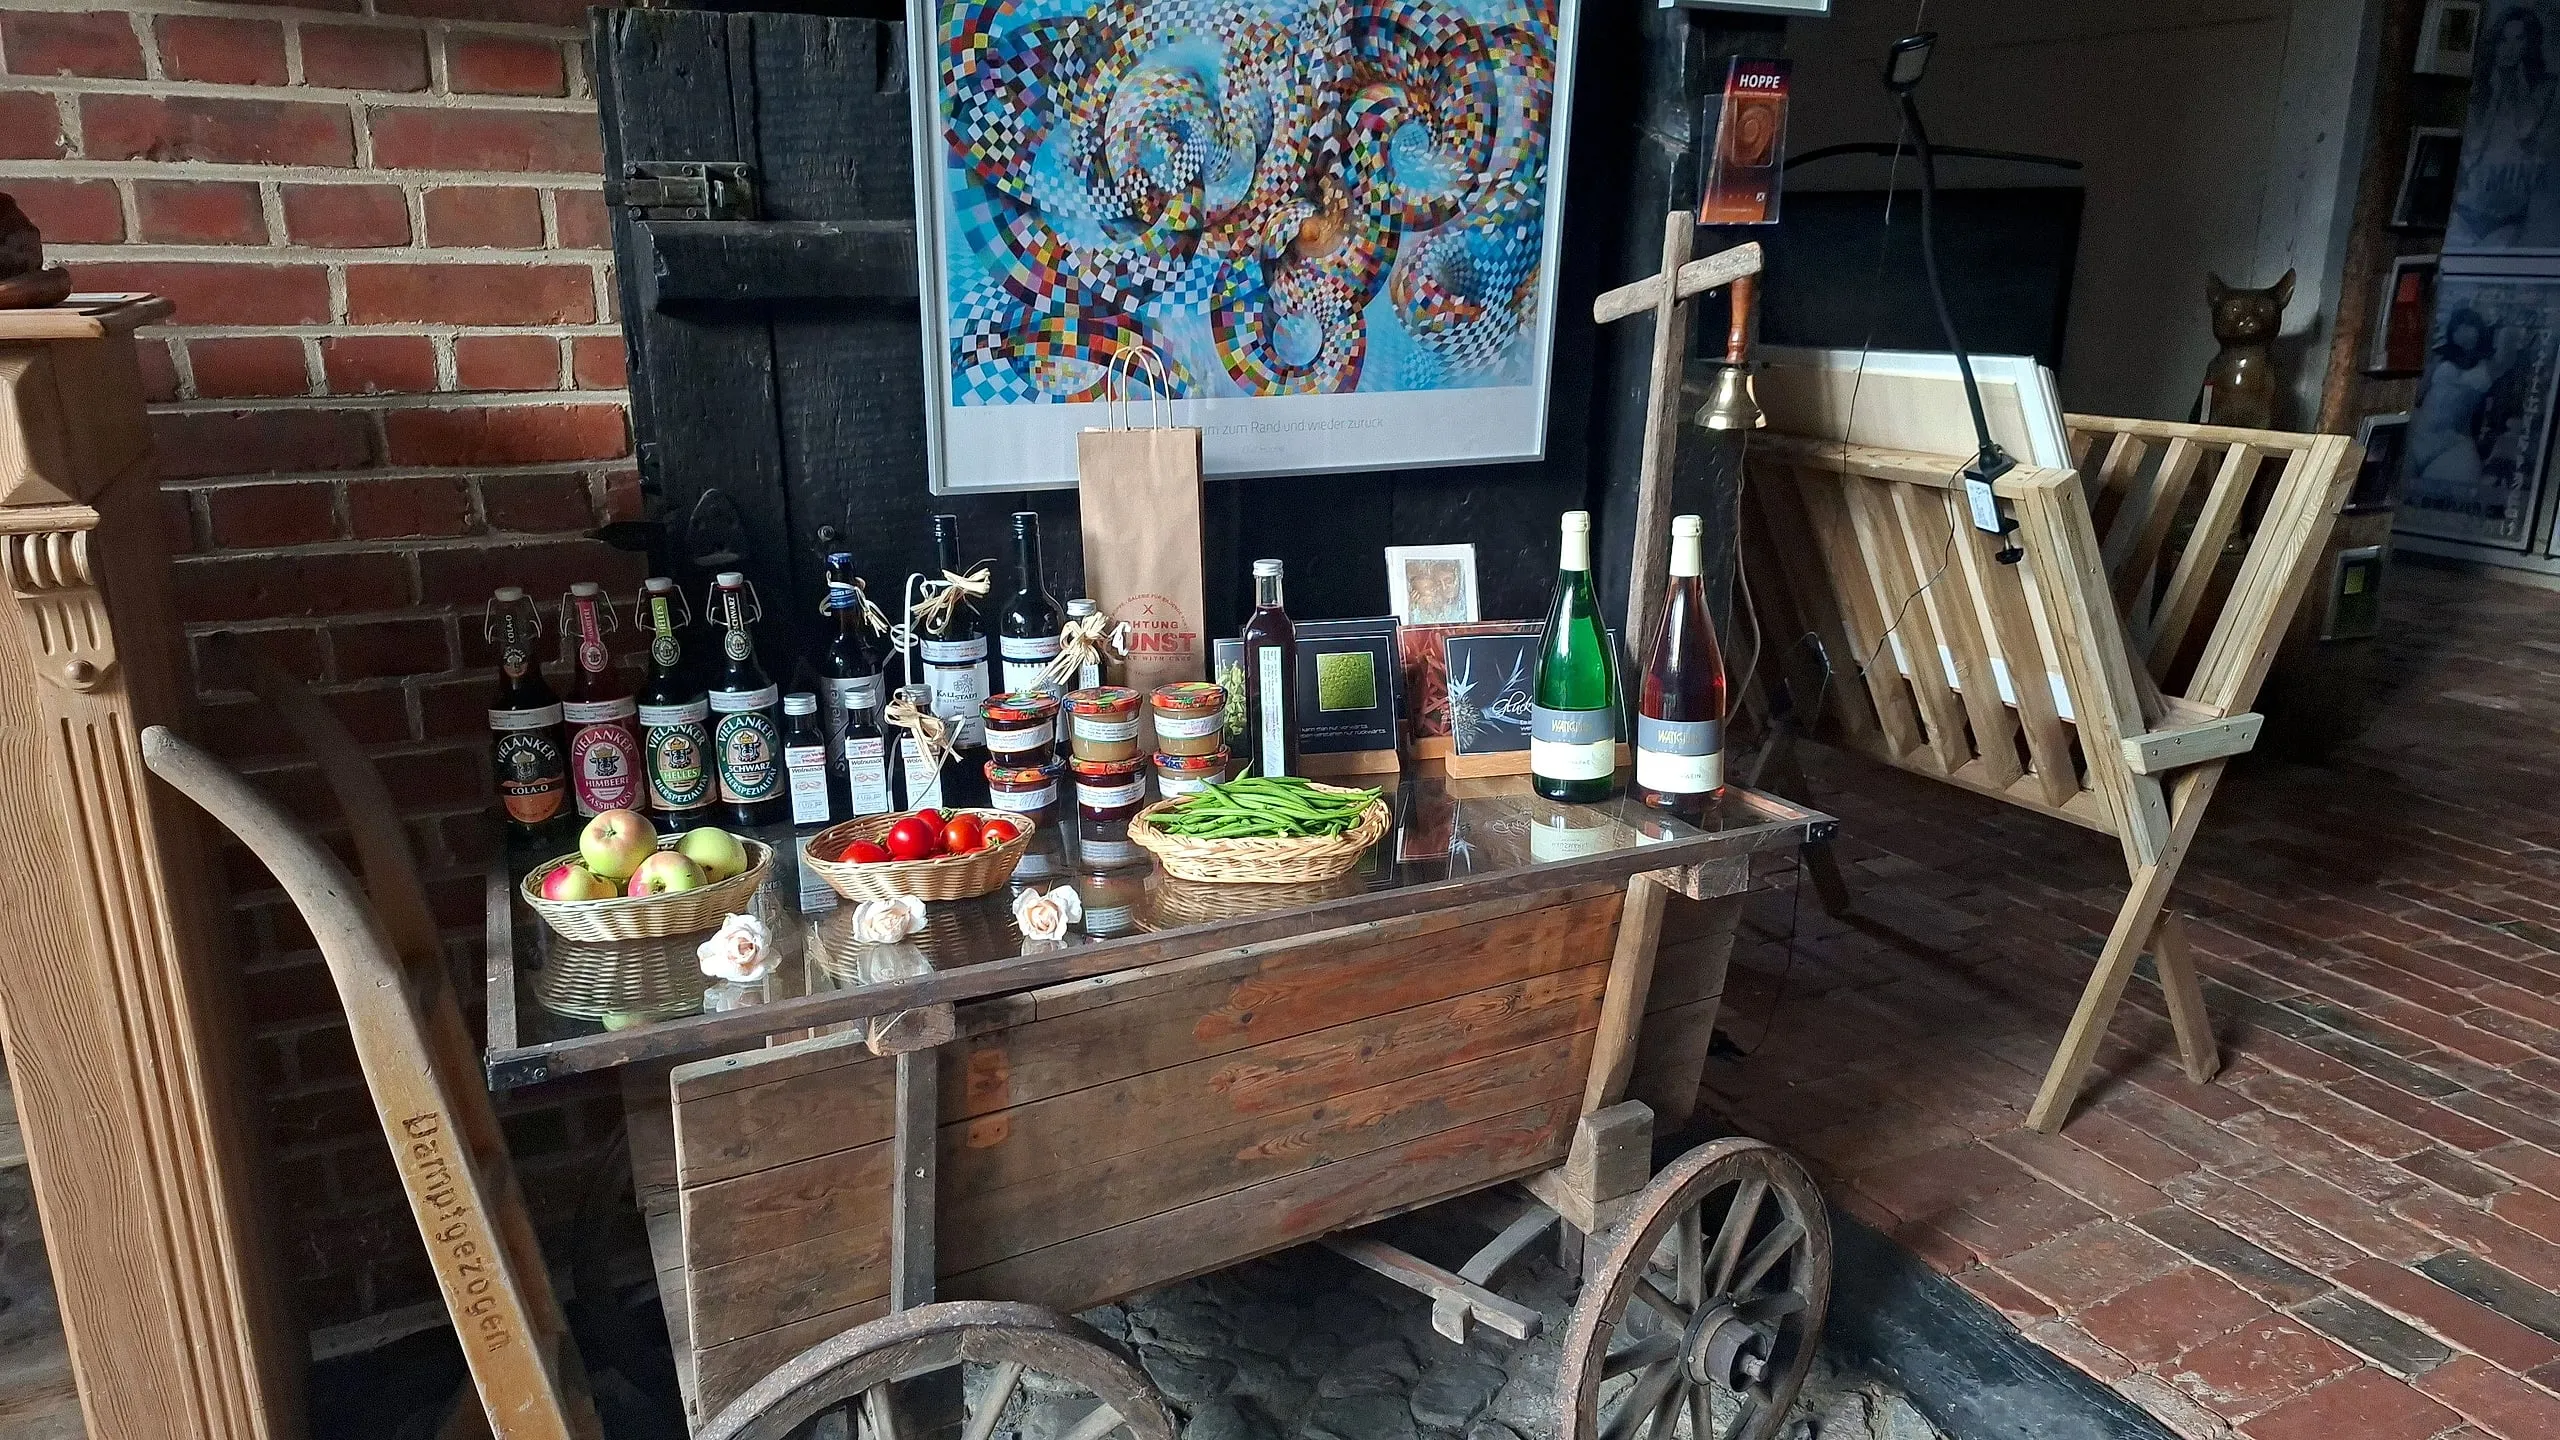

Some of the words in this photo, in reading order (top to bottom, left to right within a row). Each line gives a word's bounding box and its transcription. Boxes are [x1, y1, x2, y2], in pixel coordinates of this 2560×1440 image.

[1739, 75, 1781, 89] HOPPE
[1222, 424, 1248, 435] zum
[1251, 420, 1281, 433] Rand
[1284, 419, 1305, 432] und
[1307, 417, 1345, 431] wieder
[1126, 632, 1197, 652] UNST
[648, 724, 706, 749] VIELANKER
[718, 717, 774, 743] VIELANKER
[497, 736, 557, 764] VIELANKER
[574, 730, 634, 757] VIELANKER
[663, 768, 698, 780] HELLES
[728, 762, 771, 773] SCHWARZ
[511, 784, 549, 795] COLA-O
